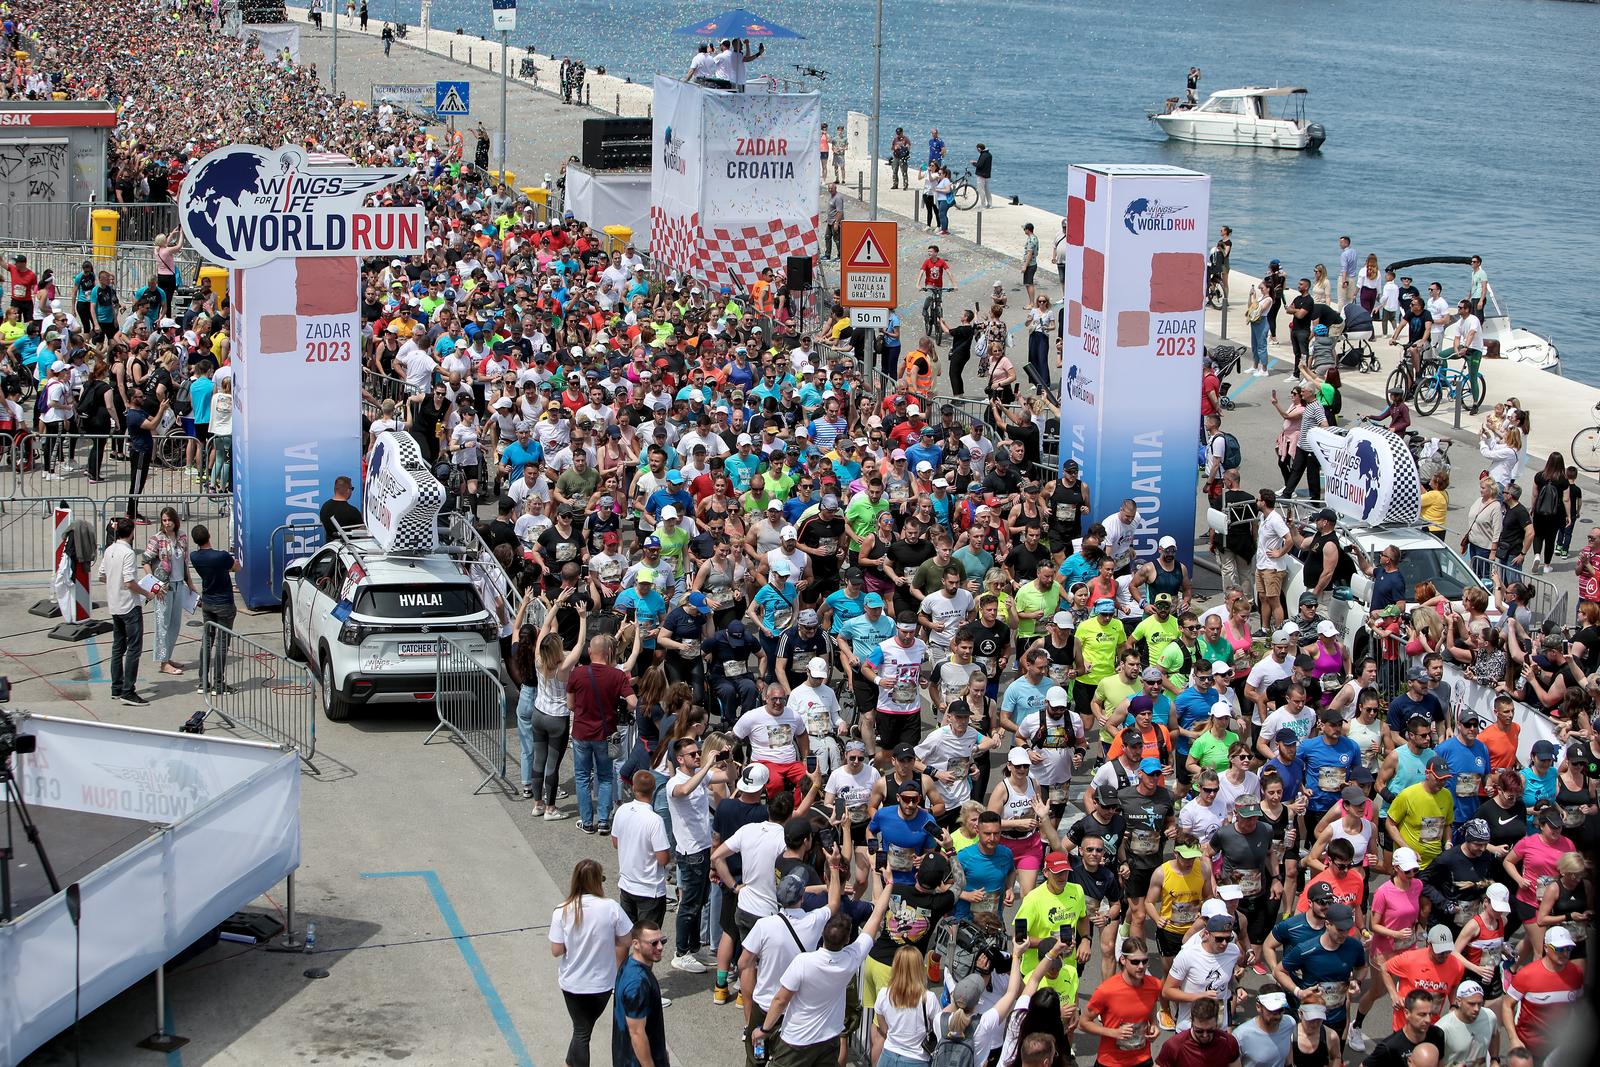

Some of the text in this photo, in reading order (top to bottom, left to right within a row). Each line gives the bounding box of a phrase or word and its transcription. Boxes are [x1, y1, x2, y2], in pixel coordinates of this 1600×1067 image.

[735, 138, 788, 156] ZADAR
[727, 161, 795, 179] CROATIA
[260, 176, 343, 195] WINGS
[254, 195, 320, 213] FOR LIFE
[850, 275, 887, 283] ULAZ/IZLAZ
[853, 283, 884, 291] VOZILA SA
[857, 313, 882, 323] 50 m
[1084, 314, 1100, 334] ZADAR
[1157, 319, 1197, 335] ZADAR
[305, 322, 351, 339] ZADAR
[305, 341, 351, 363] 2023
[1083, 332, 1100, 357] 2023
[1156, 337, 1196, 356] 2023
[1334, 449, 1361, 470] WINGS
[1334, 463, 1351, 481] LIFE
[284, 440, 320, 555] ROATIA
[1131, 430, 1164, 557] CROATIA
[400, 593, 443, 607] HVALA!
[401, 642, 448, 653] CATCHER CAR
